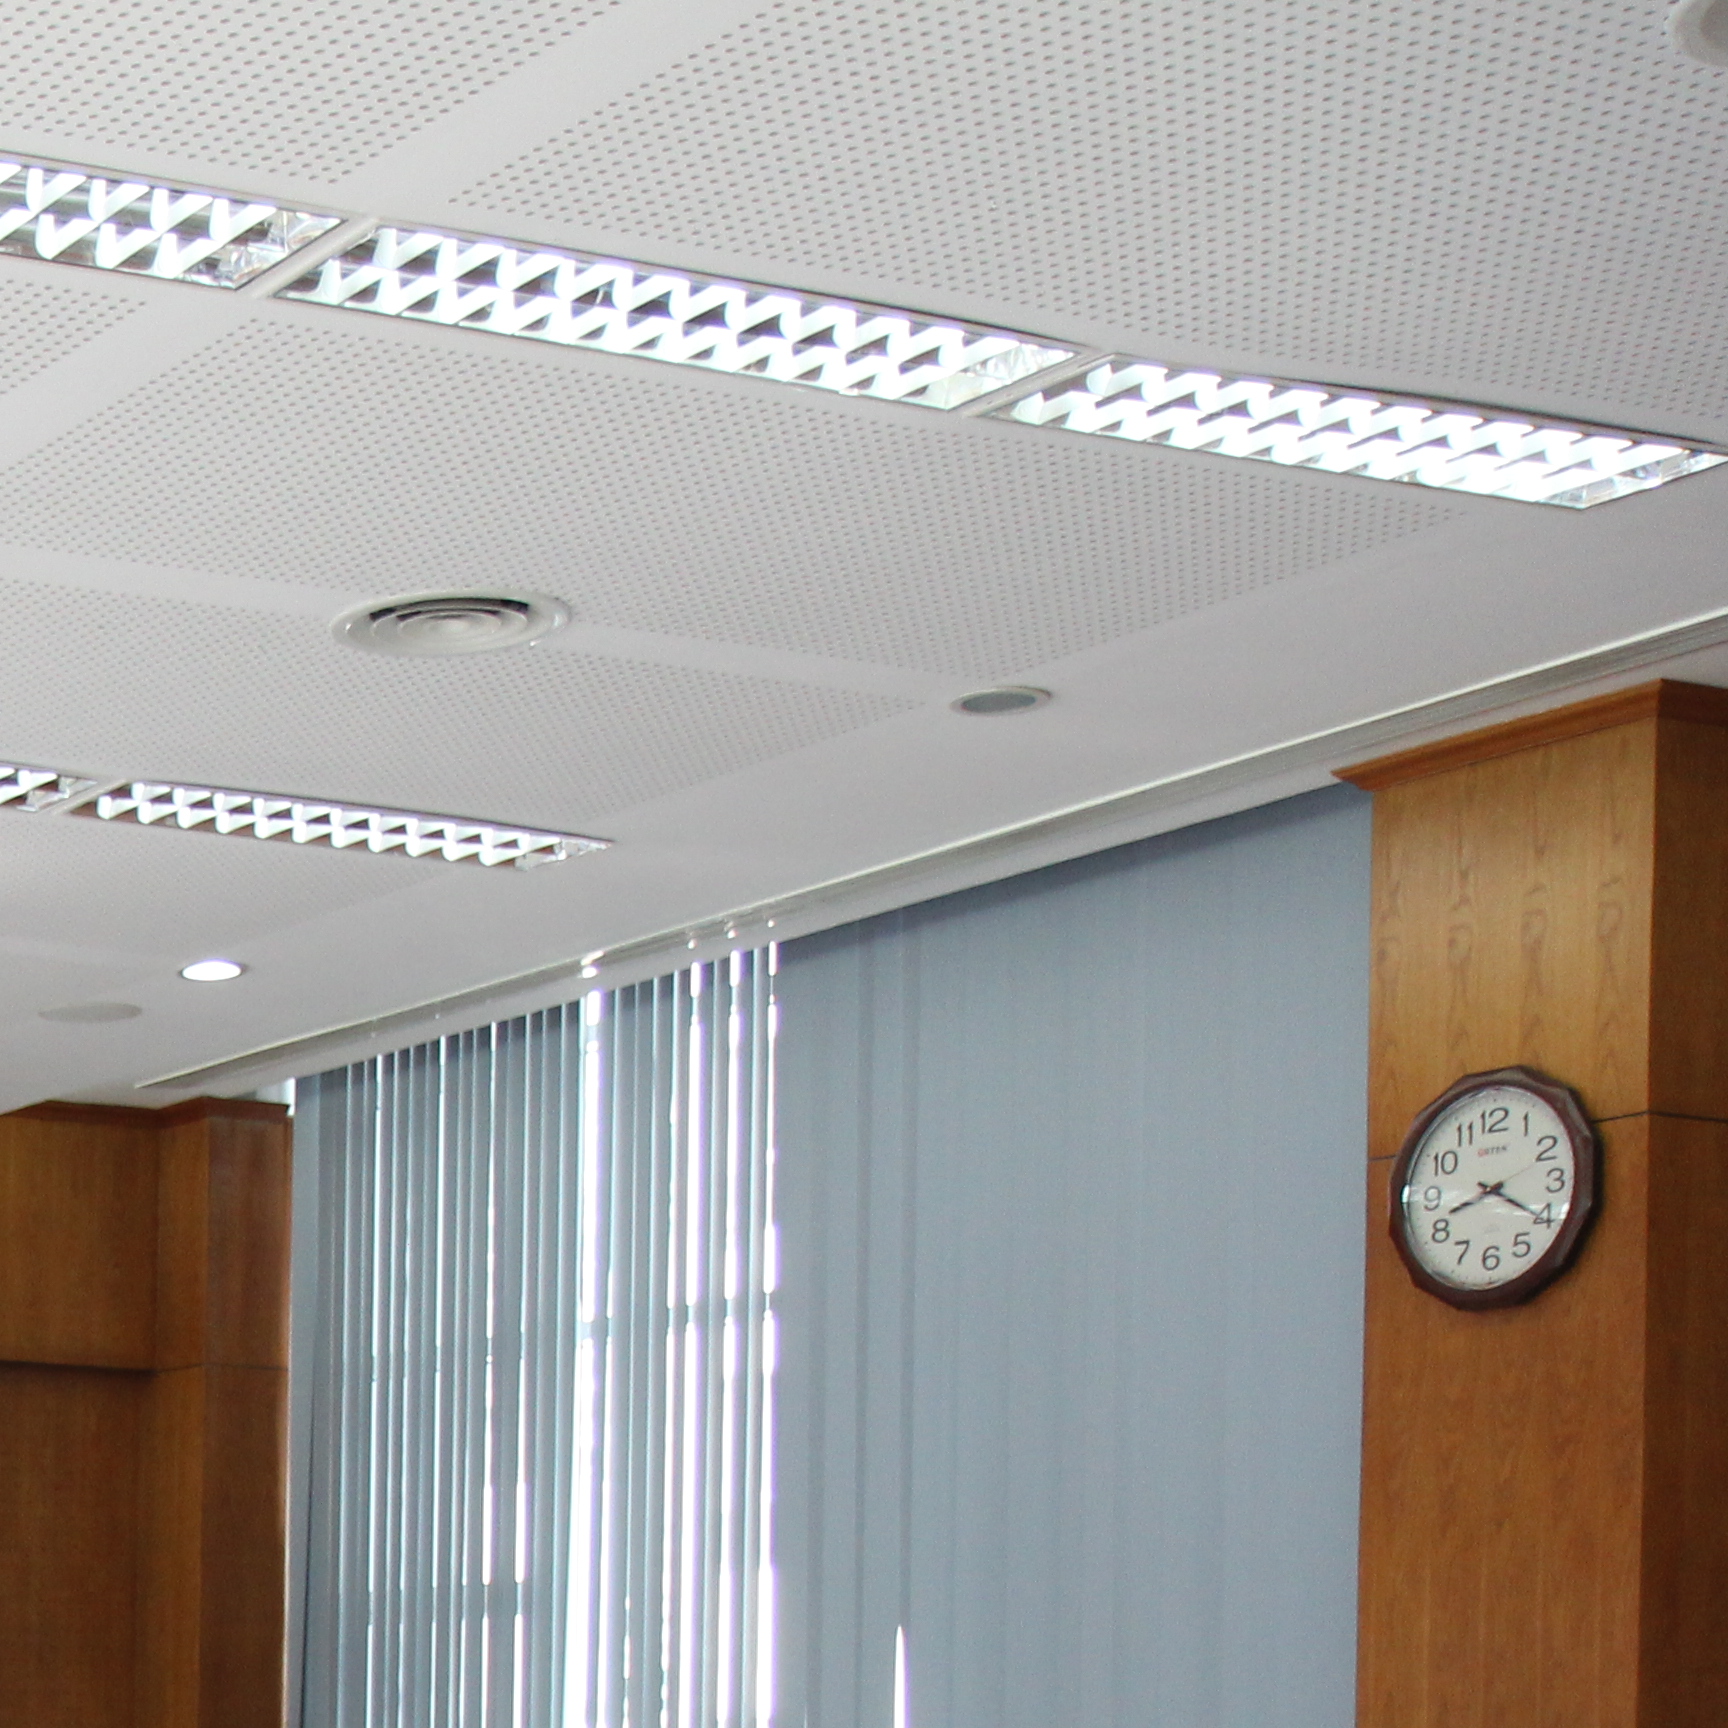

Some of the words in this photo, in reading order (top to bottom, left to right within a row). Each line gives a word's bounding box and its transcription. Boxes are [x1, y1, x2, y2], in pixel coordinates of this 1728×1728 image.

[1480, 1107, 1510, 1134] 12
[1457, 1121, 1474, 1147] 11
[1535, 1135, 1558, 1162] 2
[1433, 1150, 1458, 1177] 10
[1546, 1168, 1565, 1193] 3
[1423, 1185, 1441, 1211] 9
[1533, 1203, 1555, 1229] 4
[1432, 1219, 1450, 1243] 8
[1454, 1240, 1470, 1265] 7
[1512, 1232, 1531, 1258] 5
[1482, 1246, 1500, 1271] 6
